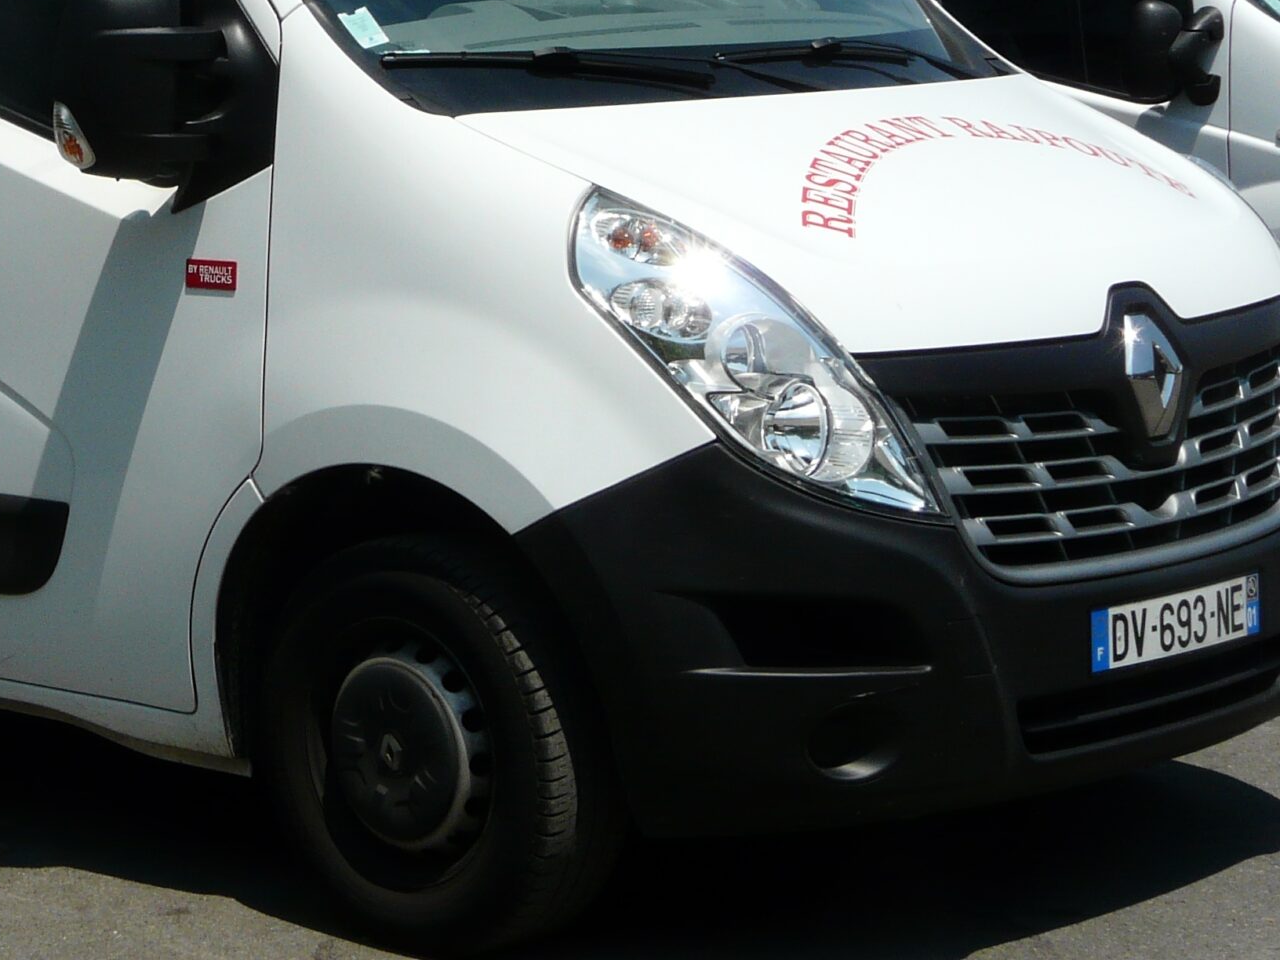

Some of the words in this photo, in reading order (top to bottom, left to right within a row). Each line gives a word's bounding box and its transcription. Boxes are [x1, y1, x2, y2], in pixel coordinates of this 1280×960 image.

[801, 115, 953, 239] RESTAURANT
[941, 116, 1198, 200] RAJPOUTE
[188, 264, 197, 273] BY
[199, 265, 233, 276] RENAULT
[200, 274, 232, 284] TRUCKS
[1097, 647, 1105, 662] F
[1112, 584, 1244, 663] DV-693-NE
[1247, 606, 1257, 627] 01
